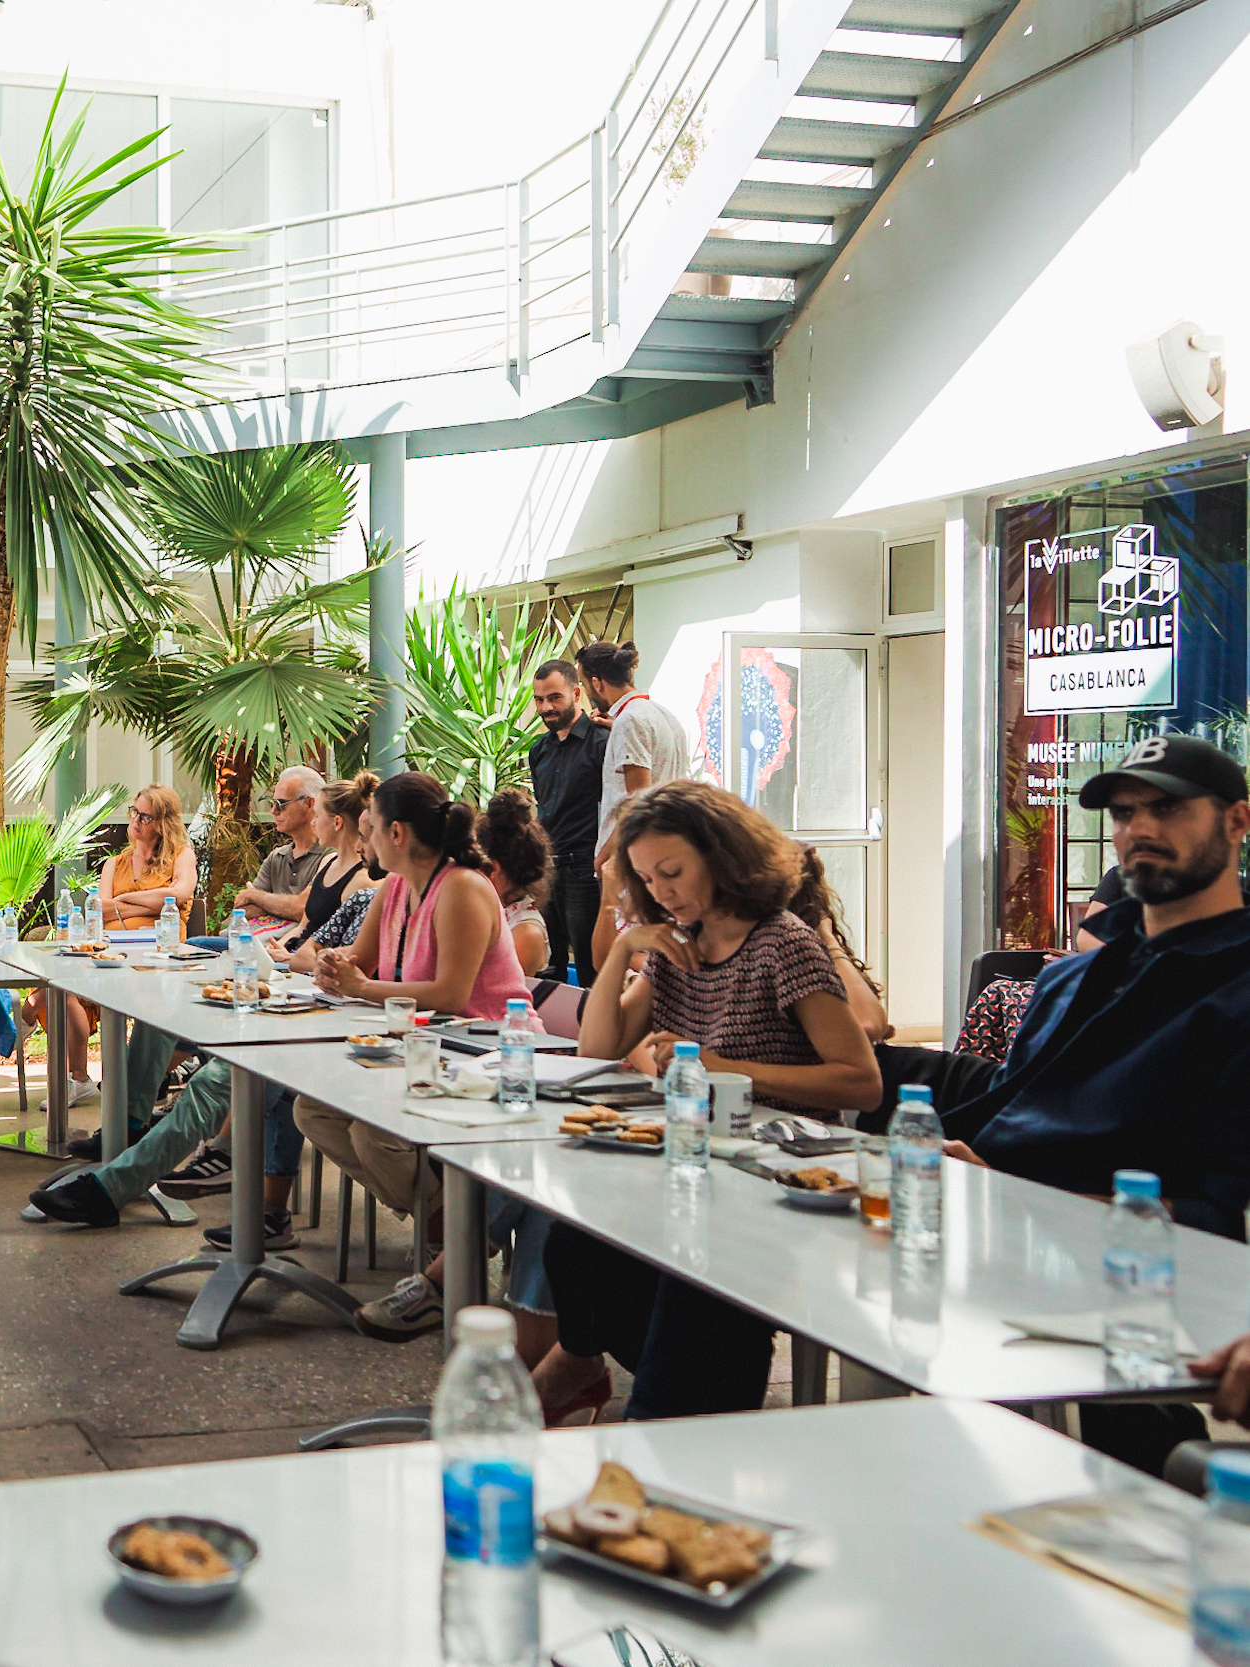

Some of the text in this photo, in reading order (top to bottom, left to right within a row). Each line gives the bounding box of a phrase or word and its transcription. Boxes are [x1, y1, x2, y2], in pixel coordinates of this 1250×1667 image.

[1028, 614, 1173, 656] MICRO-FOLIE
[1050, 668, 1146, 691] CASABLANCA
[1027, 735, 1076, 763] MUSÉE
[1028, 775, 1045, 788] Une
